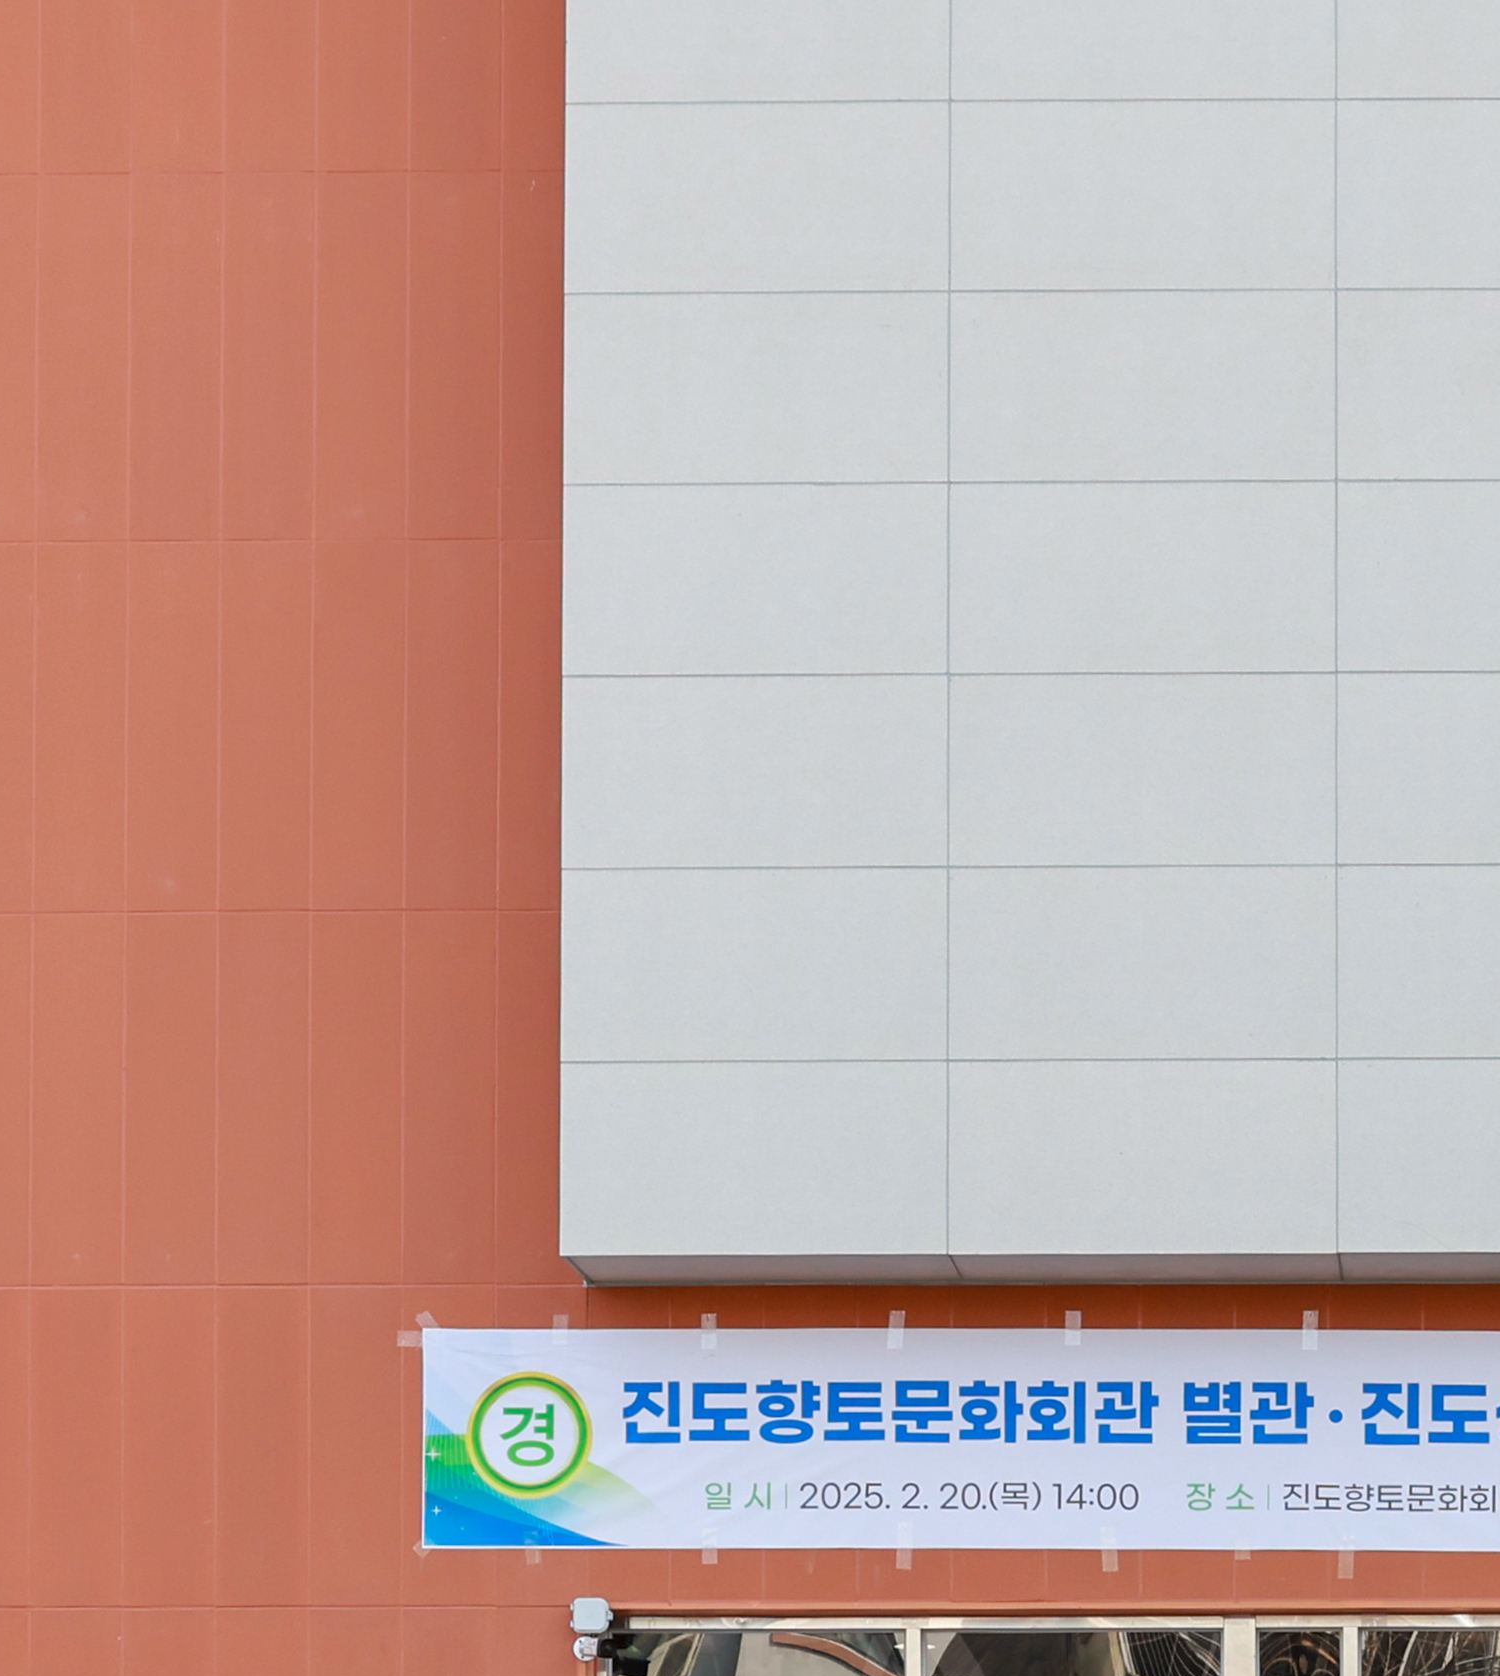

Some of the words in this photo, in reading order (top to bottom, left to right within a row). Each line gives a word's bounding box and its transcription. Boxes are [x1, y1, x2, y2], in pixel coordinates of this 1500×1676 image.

[499, 1401, 556, 1468] 경
[621, 1379, 1160, 1445] 진도향토문화회관
[705, 1482, 732, 1510] 일
[744, 1482, 771, 1510] 시
[799, 1481, 891, 1510] 2025.
[901, 1482, 929, 1510] 2.
[939, 1481, 1043, 1511] 20.(목)
[1051, 1482, 1140, 1511] 14:00
[1186, 1482, 1216, 1511] 장
[1225, 1483, 1255, 1511] 소
